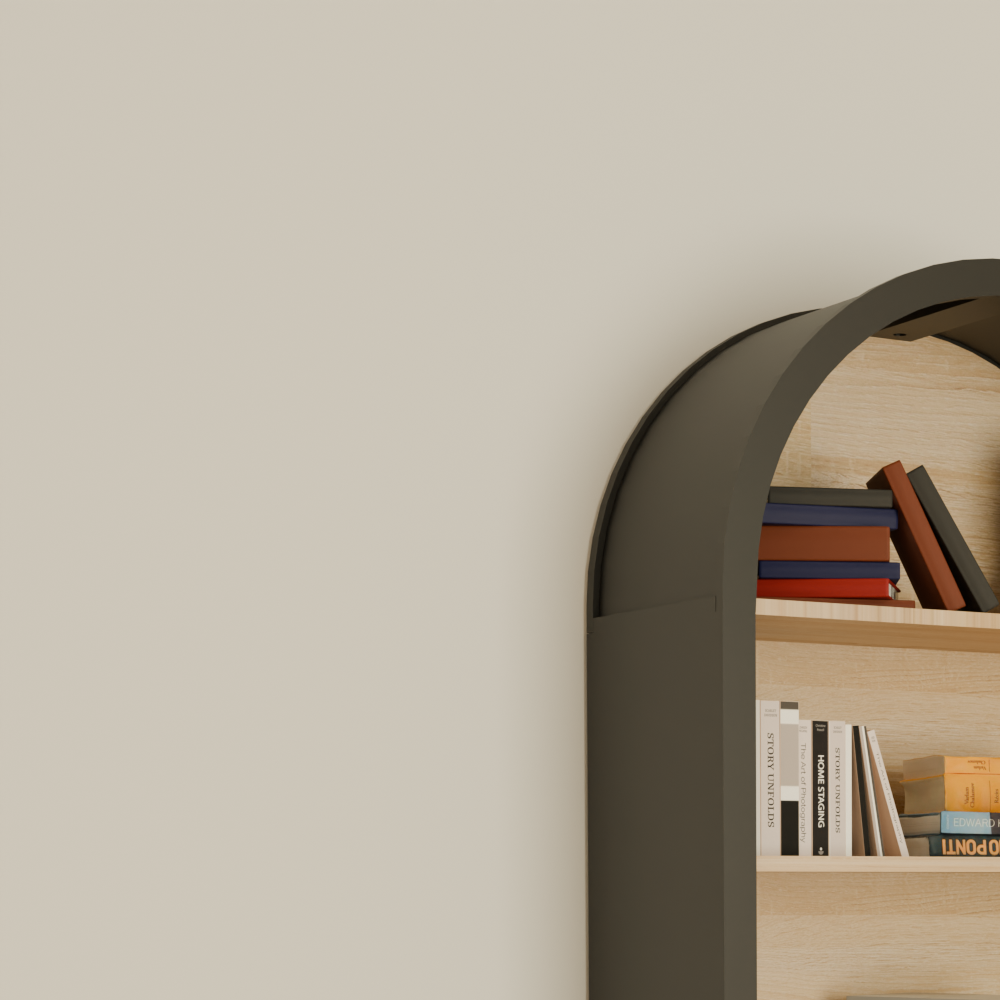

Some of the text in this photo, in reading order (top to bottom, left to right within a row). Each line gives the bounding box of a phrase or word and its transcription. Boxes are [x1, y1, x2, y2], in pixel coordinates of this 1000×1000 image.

[767, 732, 775, 828] STORY UNFOLDS
[800, 776, 807, 785] of
[817, 754, 825, 828] HOME STAGING
[799, 787, 807, 843] Photography
[953, 817, 996, 828] EDWARD
[941, 838, 987, 856] PONTI
